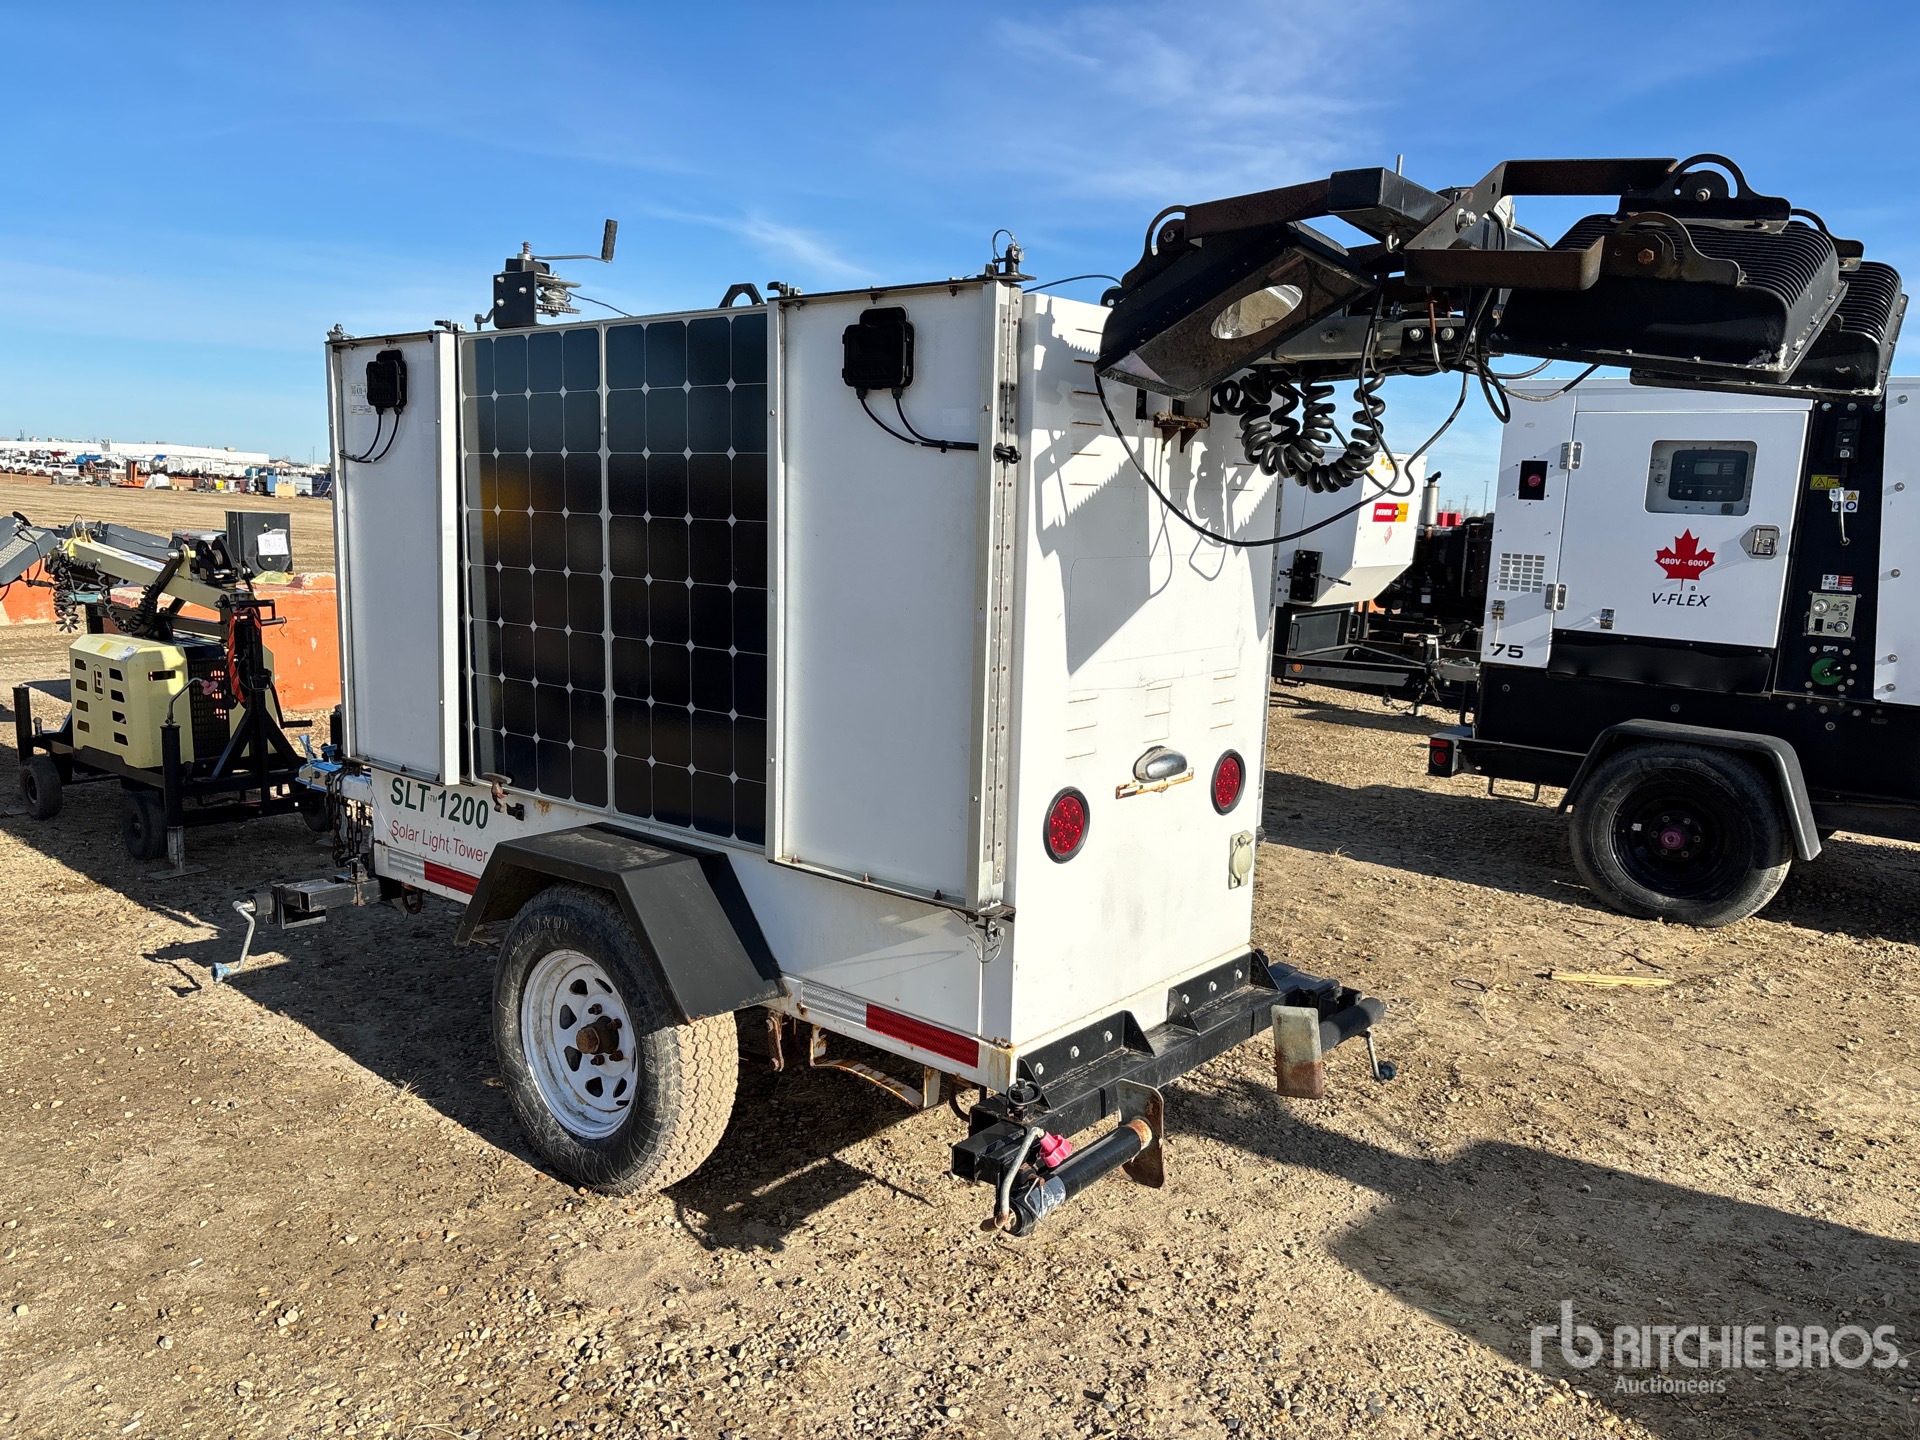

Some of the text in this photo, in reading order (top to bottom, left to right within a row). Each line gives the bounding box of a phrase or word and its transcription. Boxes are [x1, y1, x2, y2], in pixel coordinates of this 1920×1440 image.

[1688, 559, 1710, 567] 600V
[1652, 592, 1711, 607] V-FLEX
[1490, 642, 1524, 659] 75
[390, 777, 431, 812] SLT
[437, 790, 489, 830] 1200
[391, 820, 488, 863] Solar Light Tower
